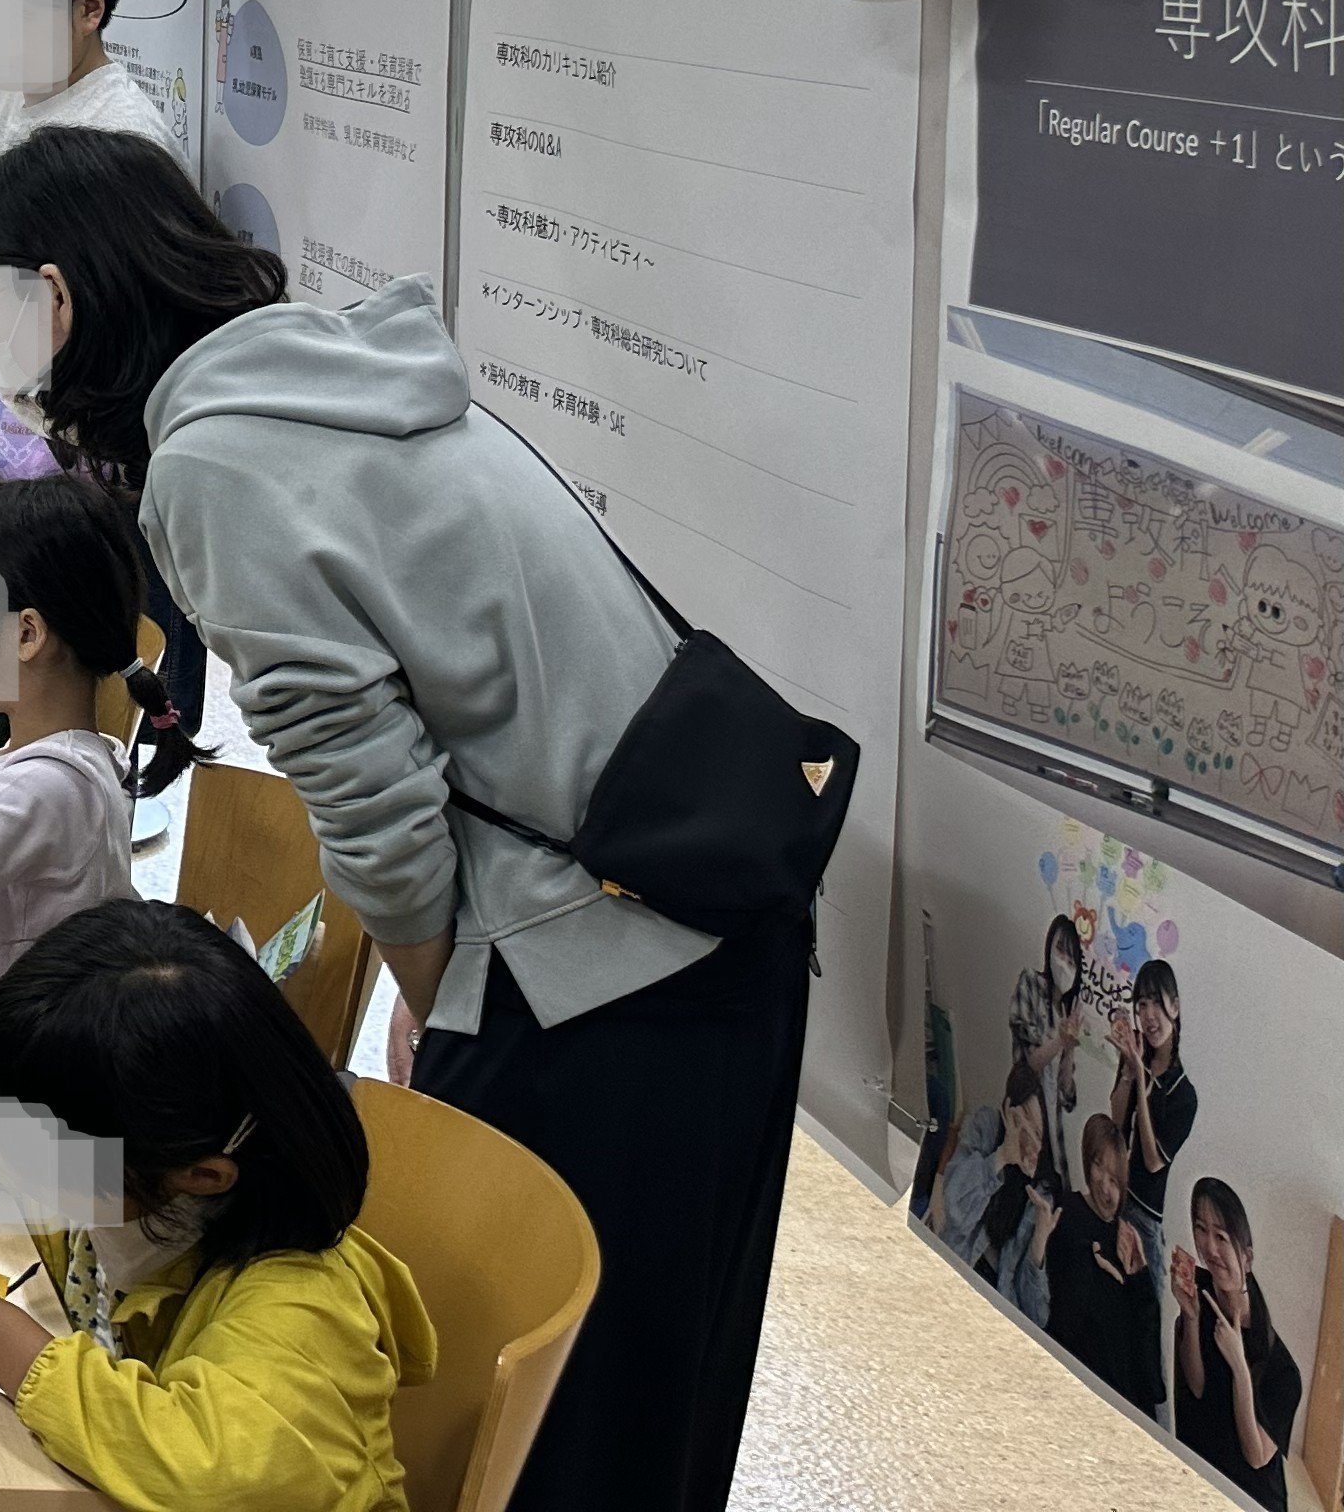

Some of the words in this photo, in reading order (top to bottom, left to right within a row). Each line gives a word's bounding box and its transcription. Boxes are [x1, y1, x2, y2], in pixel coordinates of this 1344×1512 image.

[496, 41, 616, 88] 専攻科のカリキュラム紹介
[1126, 120, 1199, 157] Course
